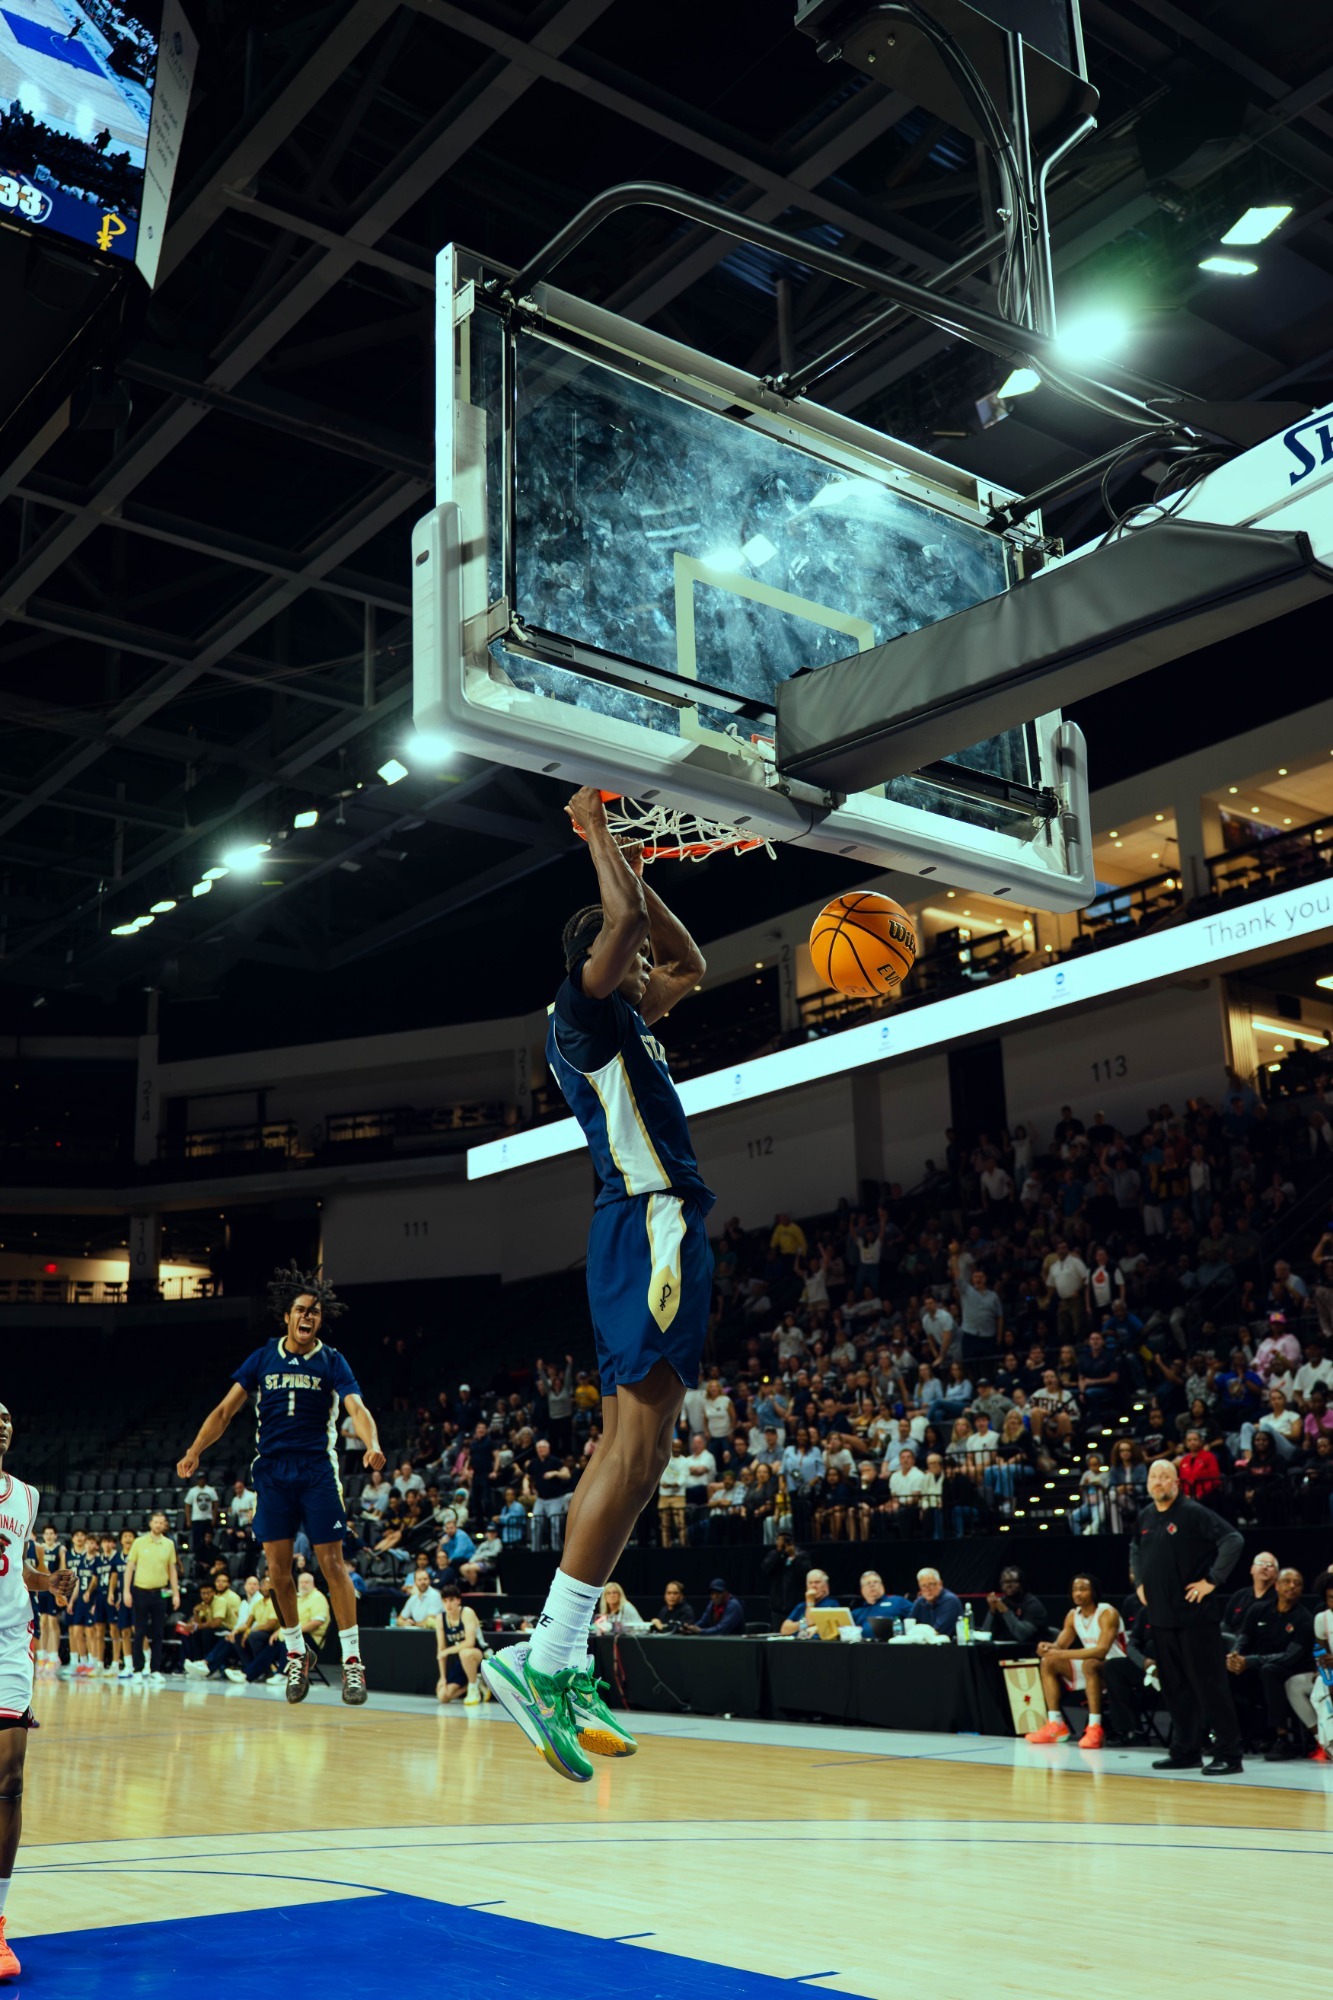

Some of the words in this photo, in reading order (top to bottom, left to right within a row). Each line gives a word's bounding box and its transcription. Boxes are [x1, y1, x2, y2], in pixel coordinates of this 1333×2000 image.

[1203, 906, 1277, 946] Thank
[1285, 896, 1330, 931] you
[781, 944, 792, 999] 217
[1091, 1054, 1129, 1083] 113
[747, 1135, 775, 1160] 112
[403, 1221, 429, 1237] 111
[287, 1390, 295, 1416] 1
